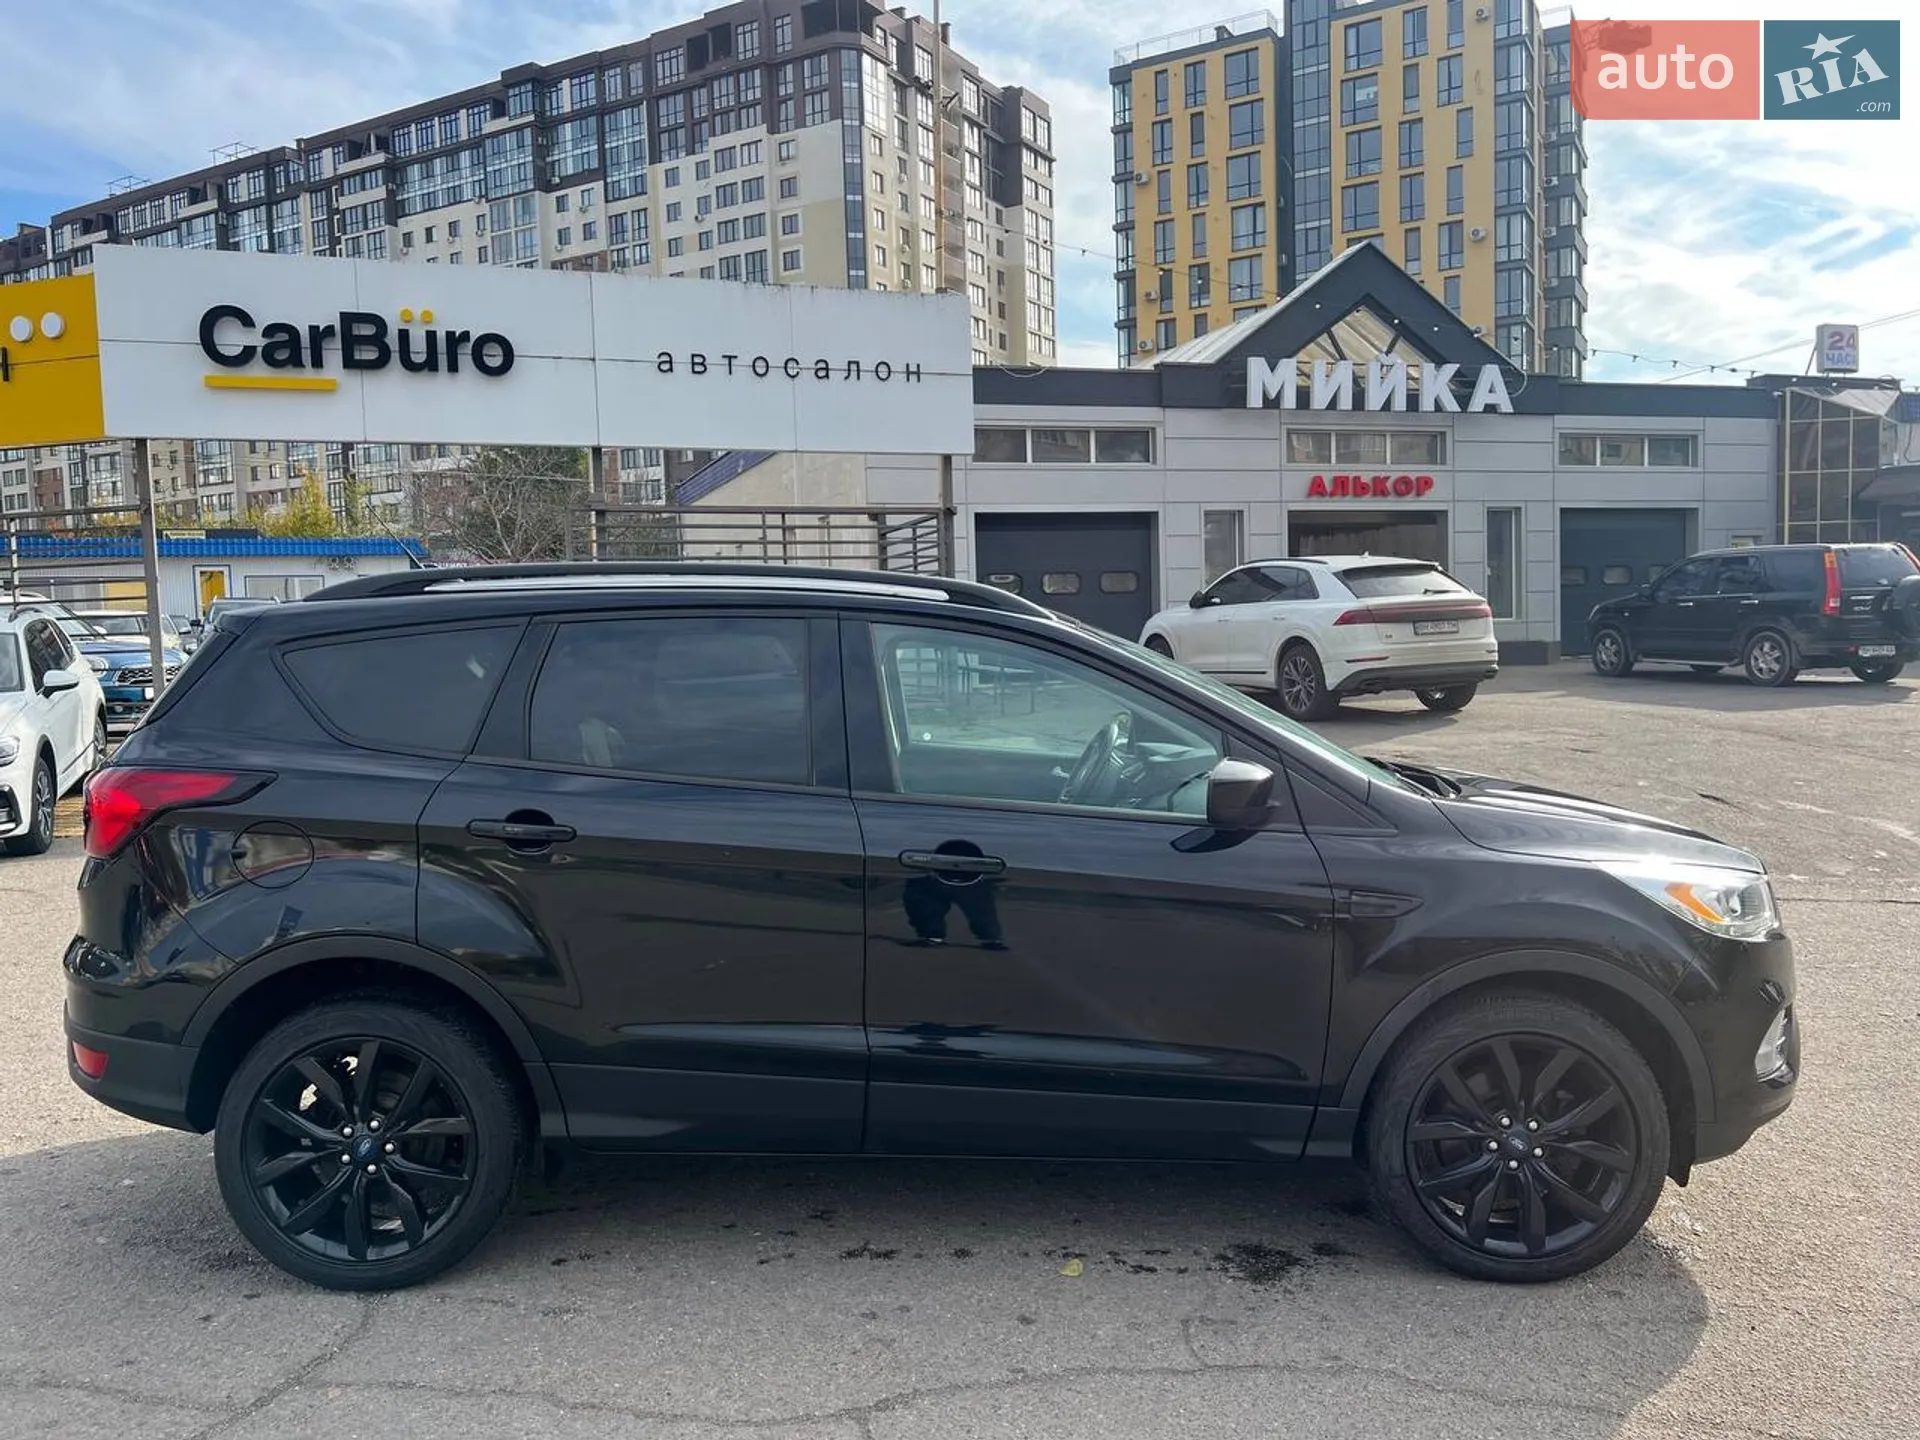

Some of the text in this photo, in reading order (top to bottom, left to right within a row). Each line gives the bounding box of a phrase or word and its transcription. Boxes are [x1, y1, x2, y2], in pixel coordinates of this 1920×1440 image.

[199, 304, 515, 378] CarBüro
[1828, 331, 1856, 350] 24
[657, 351, 922, 383] автосалон
[1825, 352, 1856, 366] ЧАС
[1246, 351, 1515, 413] МИЙКА
[1308, 475, 1434, 497] АЛЬКОР
